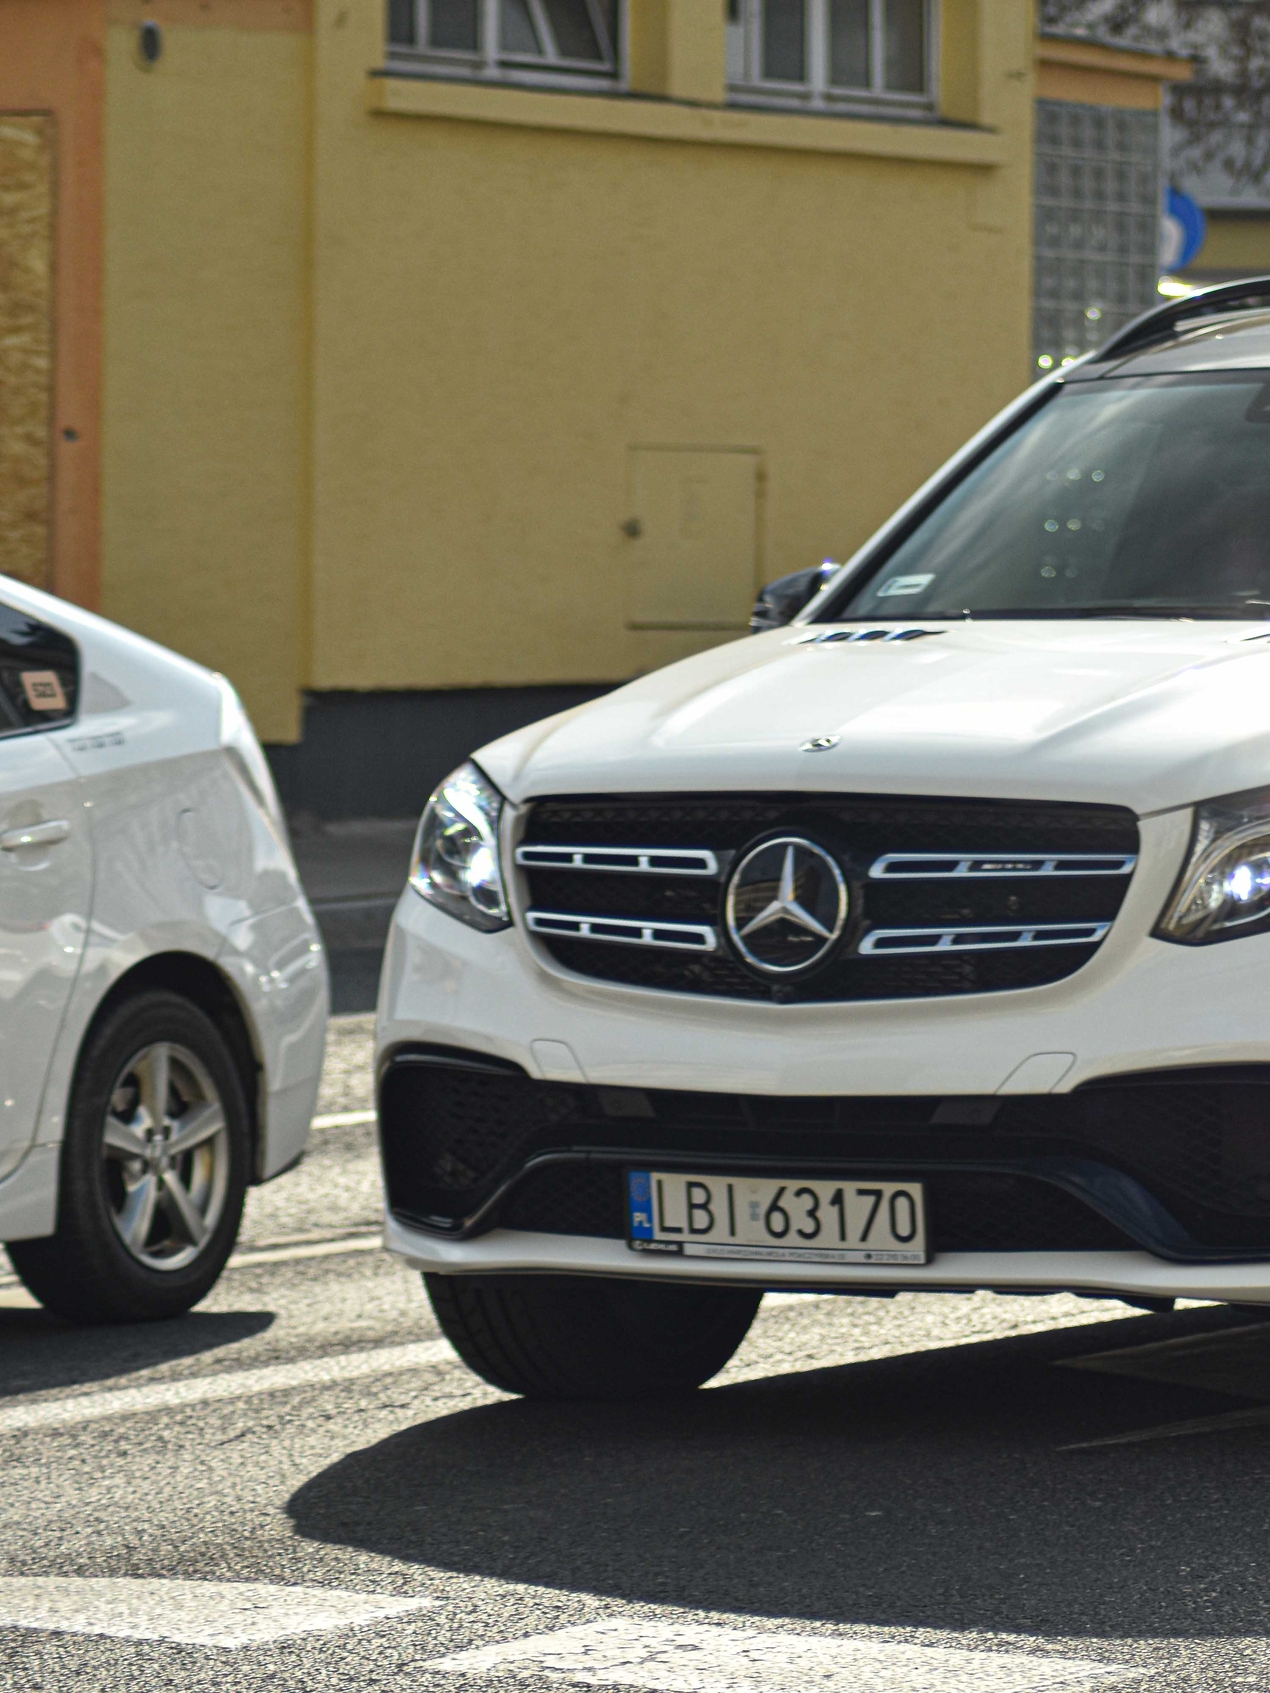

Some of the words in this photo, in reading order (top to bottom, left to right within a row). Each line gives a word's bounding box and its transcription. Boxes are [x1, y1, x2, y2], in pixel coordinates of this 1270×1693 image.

[632, 1212, 652, 1228] PL
[656, 1179, 737, 1238] LBI
[765, 1185, 917, 1243] 63170
